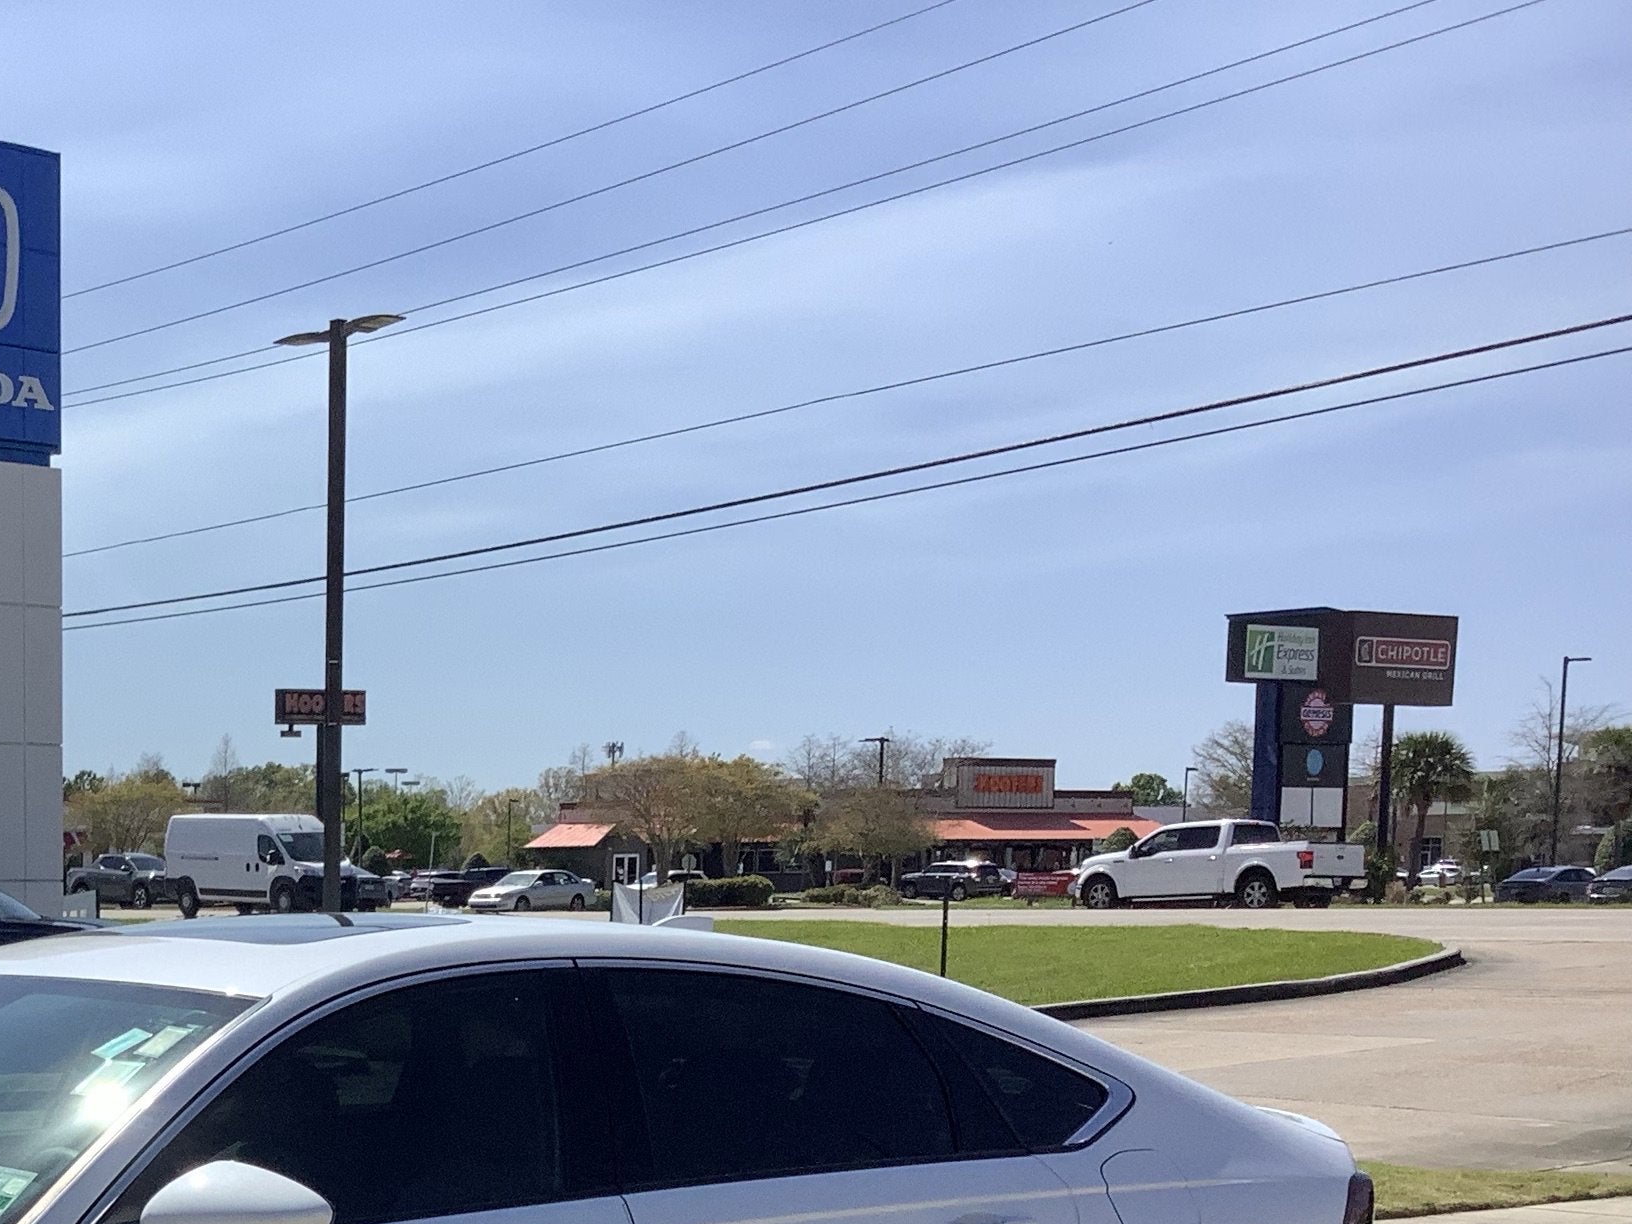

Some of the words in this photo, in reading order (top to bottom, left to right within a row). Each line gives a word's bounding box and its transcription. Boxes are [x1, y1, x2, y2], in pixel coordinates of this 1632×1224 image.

[1276, 644, 1315, 661] Express
[1378, 645, 1446, 662] CHIPOTLE
[285, 693, 364, 713] HOORS
